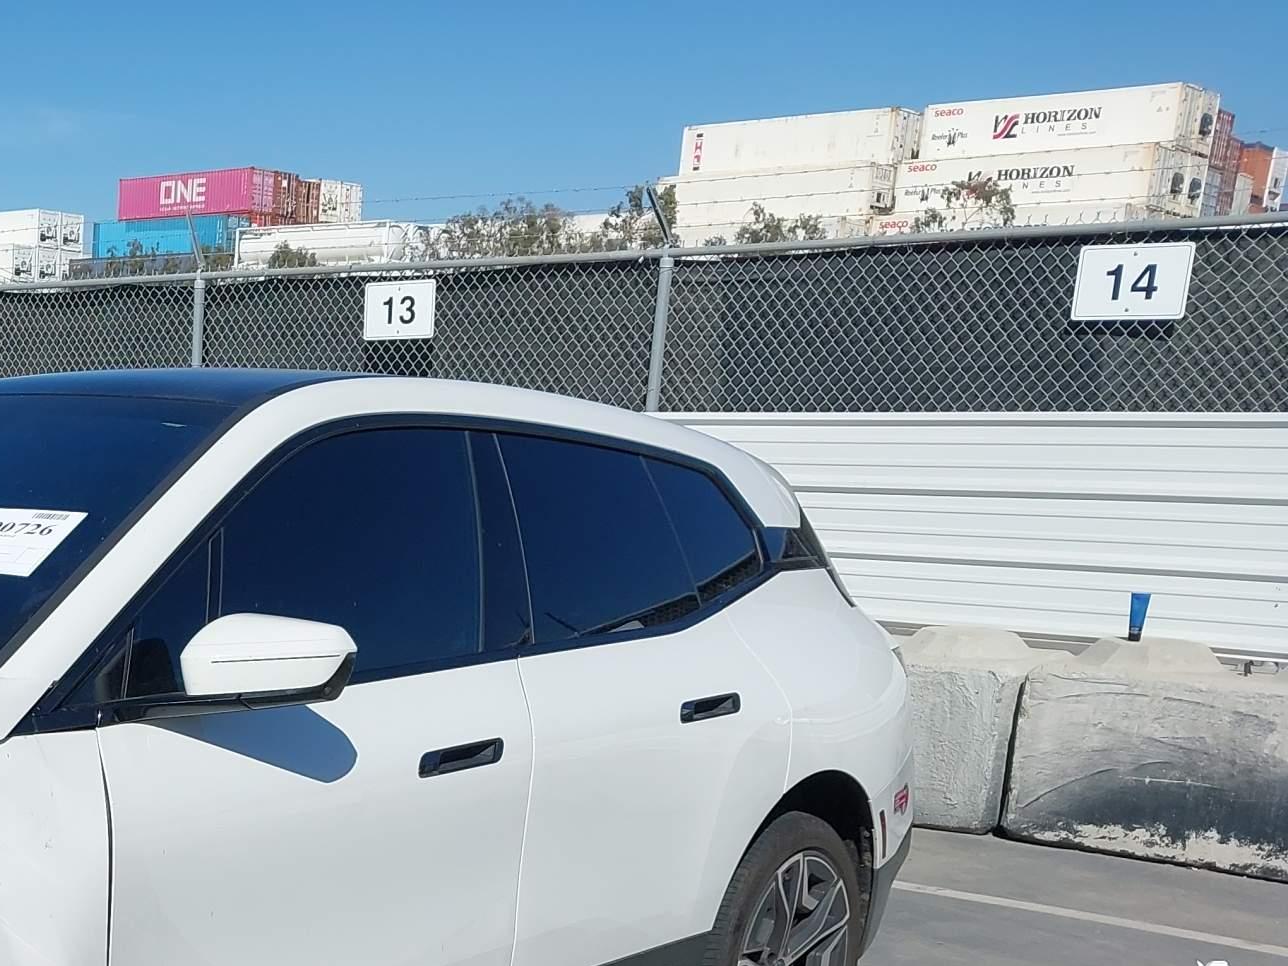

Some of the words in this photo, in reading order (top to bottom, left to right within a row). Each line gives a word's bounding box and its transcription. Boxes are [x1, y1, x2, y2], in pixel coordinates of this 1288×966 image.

[935, 108, 964, 117] seaco
[1023, 107, 1102, 124] HORIZON
[1021, 123, 1087, 134] LINES
[907, 163, 937, 173] seaco
[997, 166, 1075, 181] HORIZON
[159, 178, 206, 204] ONE
[879, 219, 908, 231] seaco
[1106, 263, 1158, 301] 14
[383, 295, 415, 325] 13
